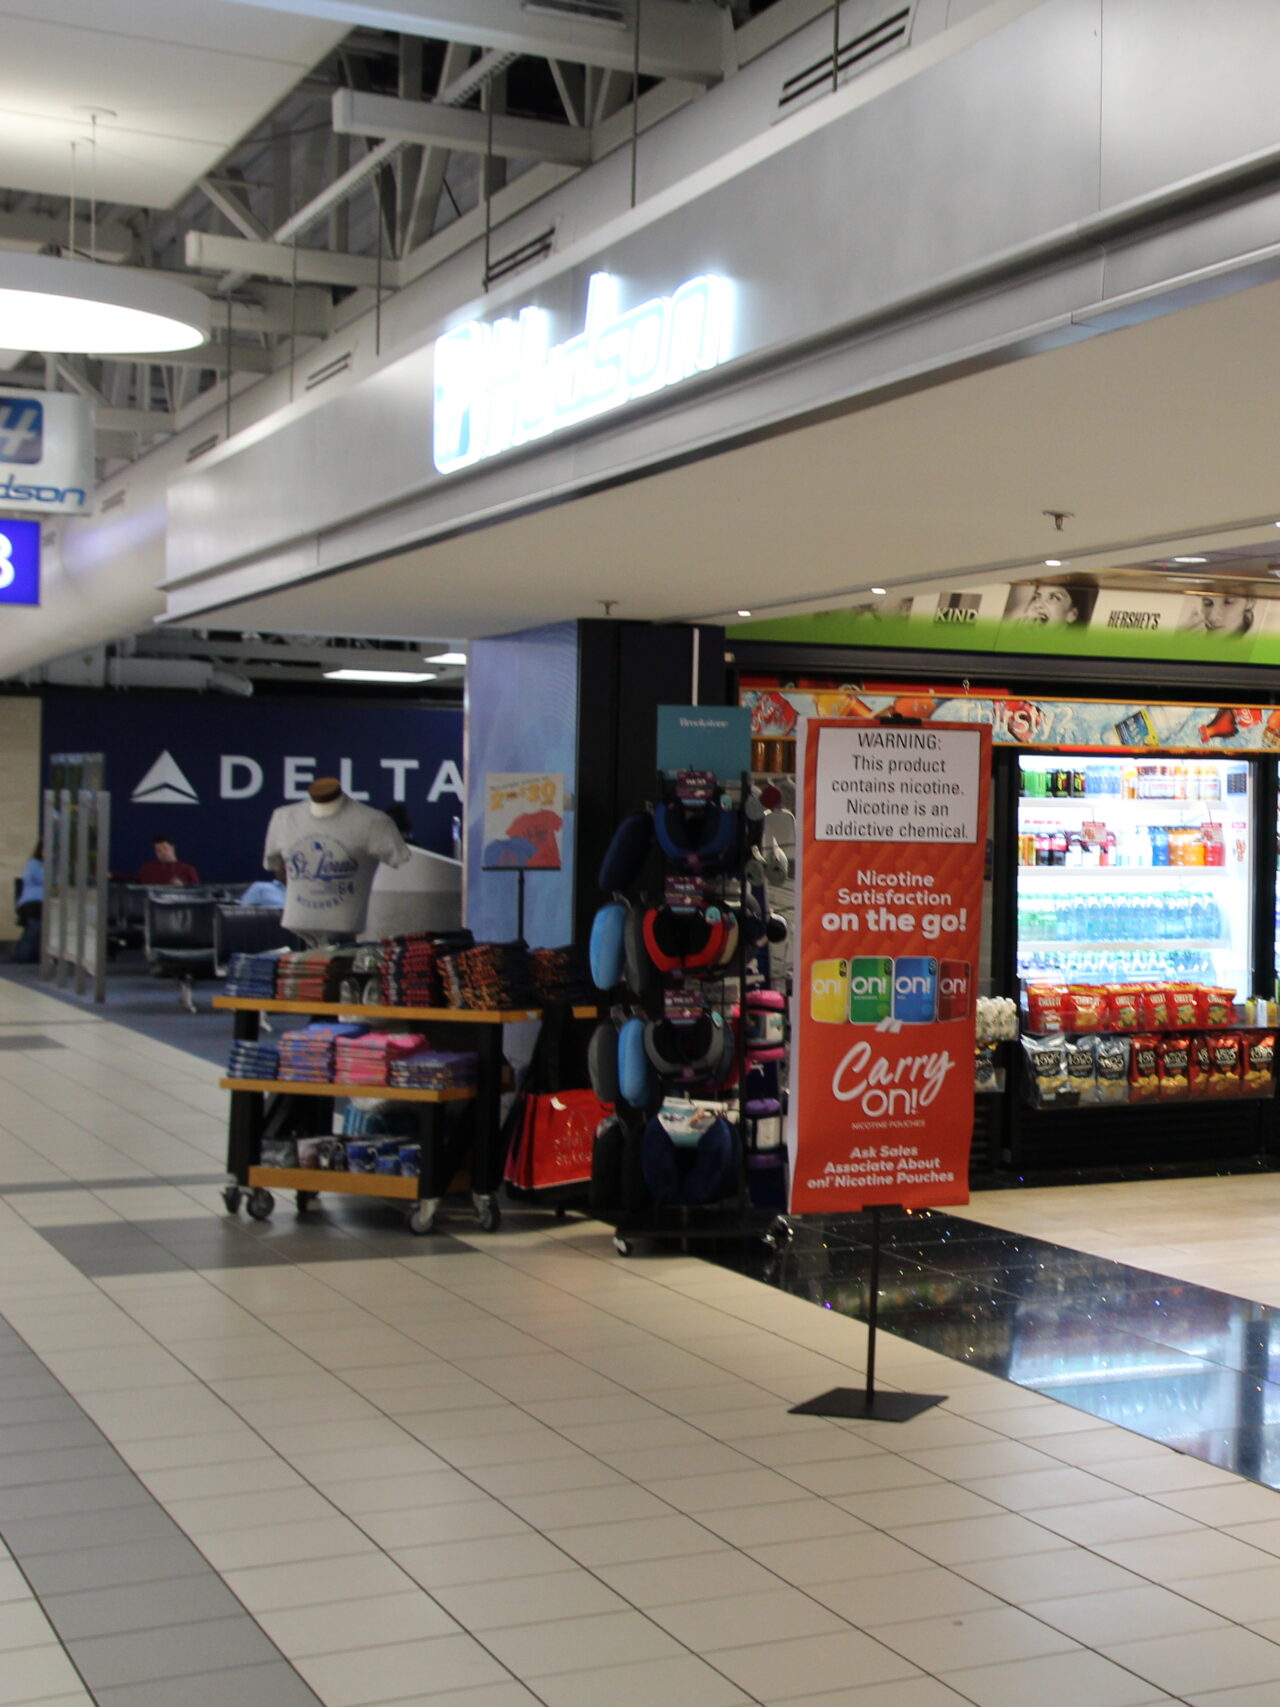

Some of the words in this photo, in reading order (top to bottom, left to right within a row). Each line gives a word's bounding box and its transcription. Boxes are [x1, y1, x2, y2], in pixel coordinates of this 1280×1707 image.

[934, 607, 977, 624] KIND
[858, 732, 941, 750] WARNING:
[852, 755, 883, 771] This
[888, 757, 946, 774] product
[219, 754, 464, 802] DELTA
[832, 778, 895, 793] contains
[900, 781, 964, 796] nicotine.
[846, 800, 909, 815] Nicotine
[914, 803, 927, 816] is
[931, 805, 949, 816] an
[825, 821, 894, 837] addictive
[899, 823, 968, 839] chemical.
[857, 870, 935, 887] Nicotine
[837, 887, 952, 905] Satisfaction
[821, 912, 859, 932] on
[865, 907, 916, 932] the
[921, 908, 967, 940] go!
[832, 1041, 956, 1106] Carry
[861, 1088, 918, 1117] on!
[849, 1147, 877, 1159] Ask
[880, 1145, 918, 1158] Sales
[824, 1161, 895, 1174] Associate
[897, 1158, 941, 1171] About
[834, 1173, 893, 1187] Nicotine
[896, 1171, 955, 1184] Pouches
